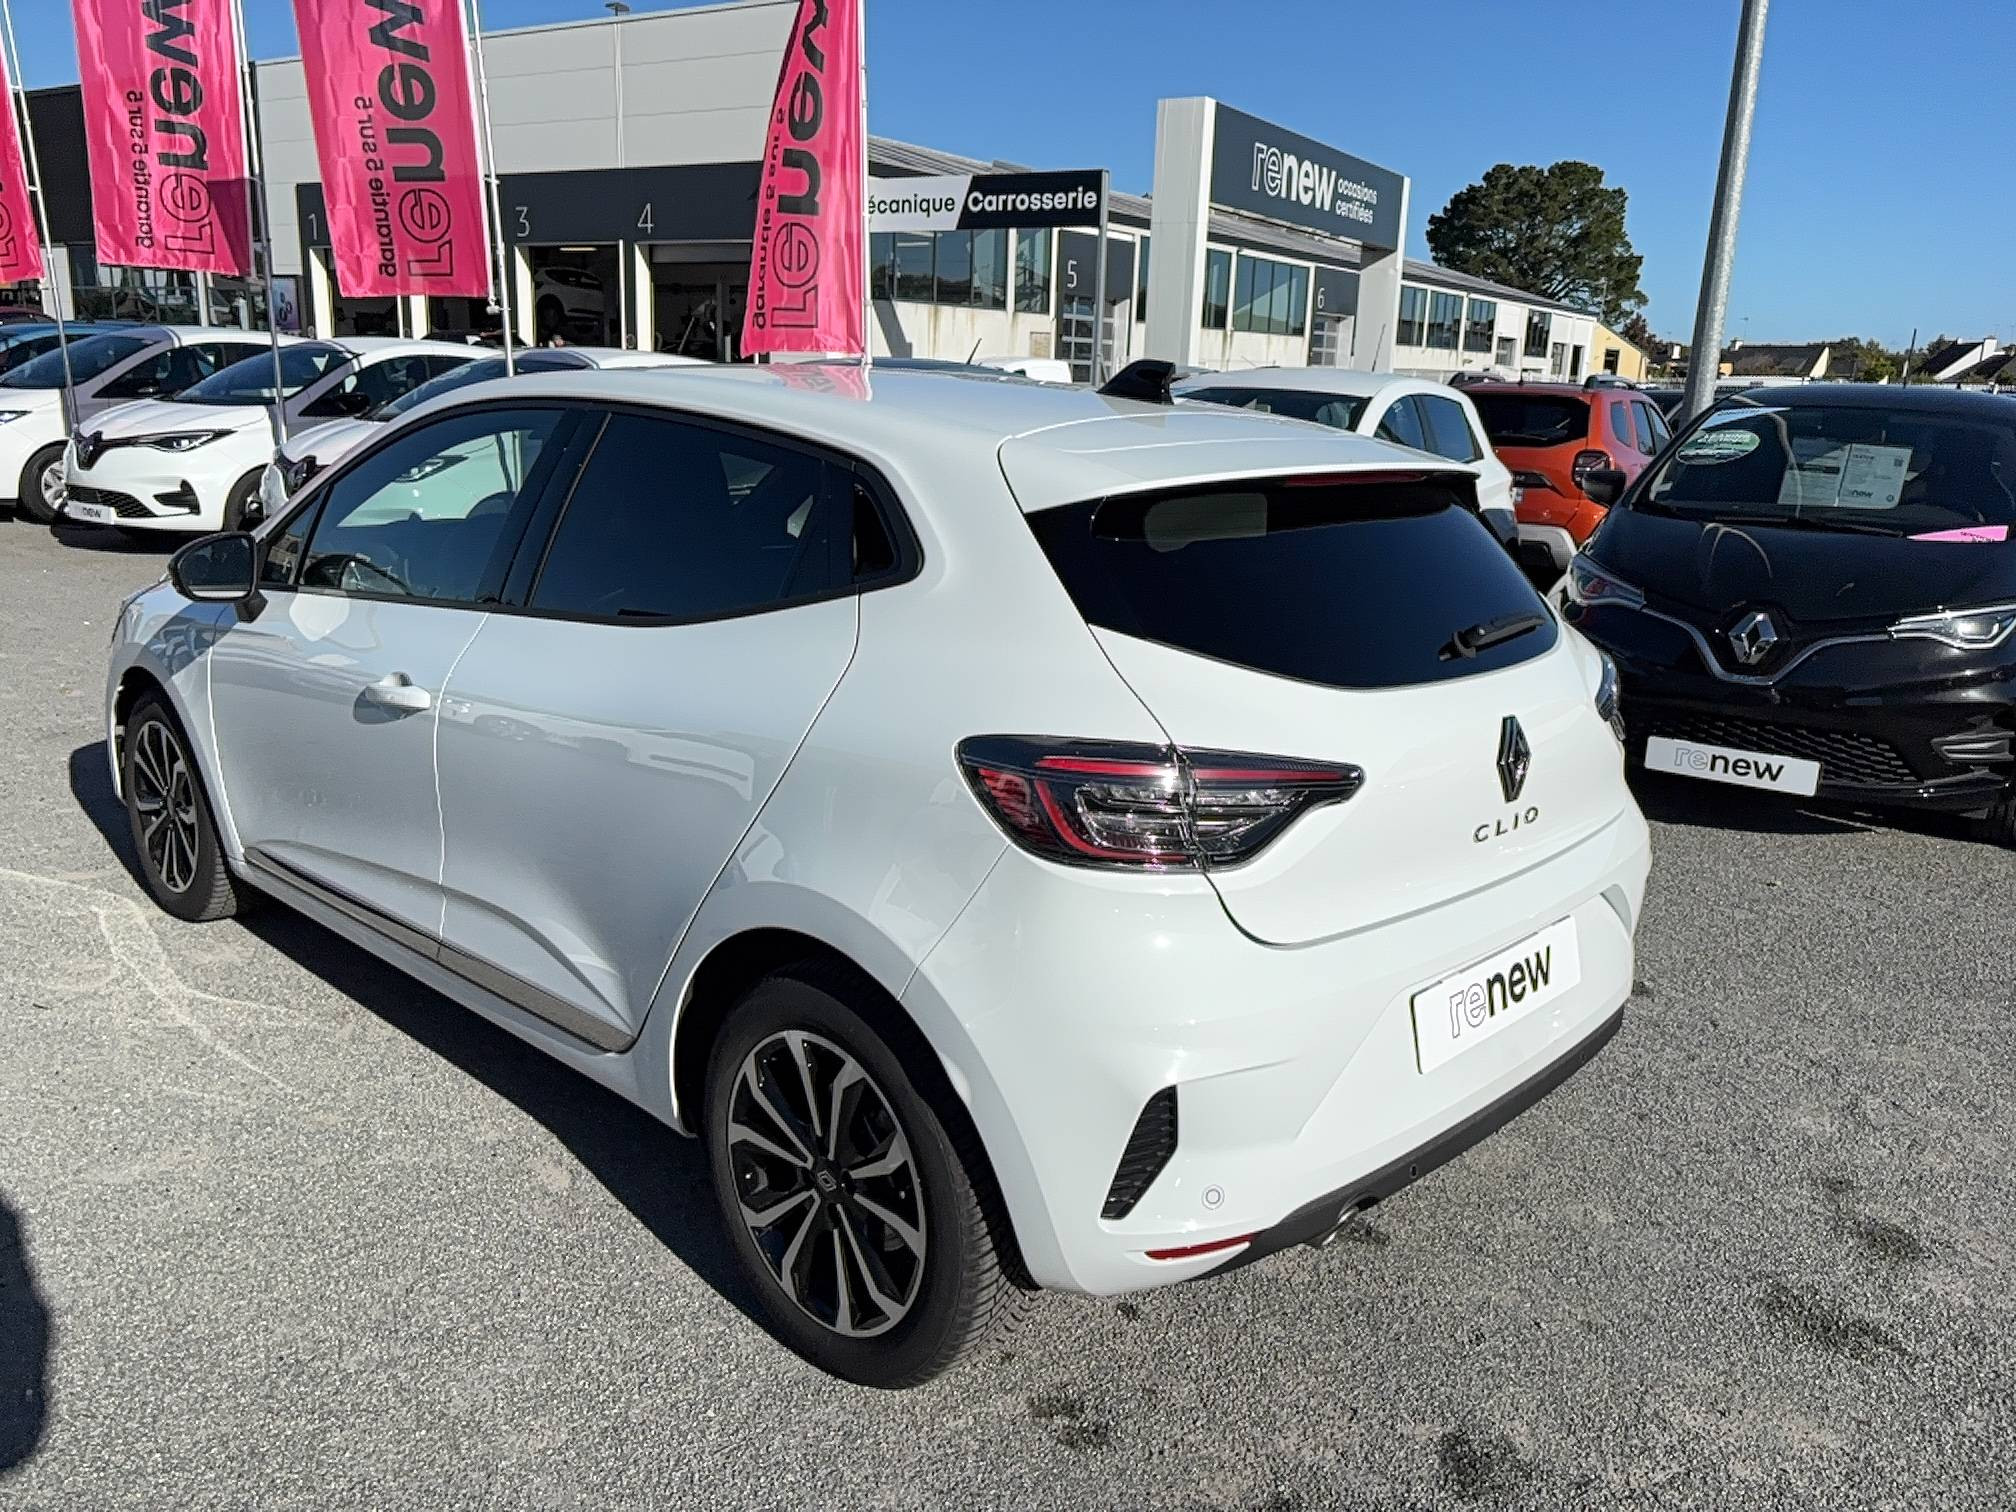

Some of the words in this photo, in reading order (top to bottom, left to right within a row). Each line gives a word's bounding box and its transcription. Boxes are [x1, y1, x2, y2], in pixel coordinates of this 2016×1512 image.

[1252, 141, 1337, 212] renew
[1337, 177, 1378, 205] occasions
[869, 192, 955, 217] écanique
[967, 186, 1098, 213] Carrosserie
[1335, 199, 1374, 224] certifiées
[308, 213, 318, 241] 1
[515, 206, 530, 237] 3
[637, 203, 654, 234] 4
[1066, 259, 1078, 288] 5
[1317, 287, 1326, 309] 6
[1674, 747, 1784, 782] renew
[1473, 806, 1539, 843] CLIO
[1449, 944, 1551, 1039] renew
